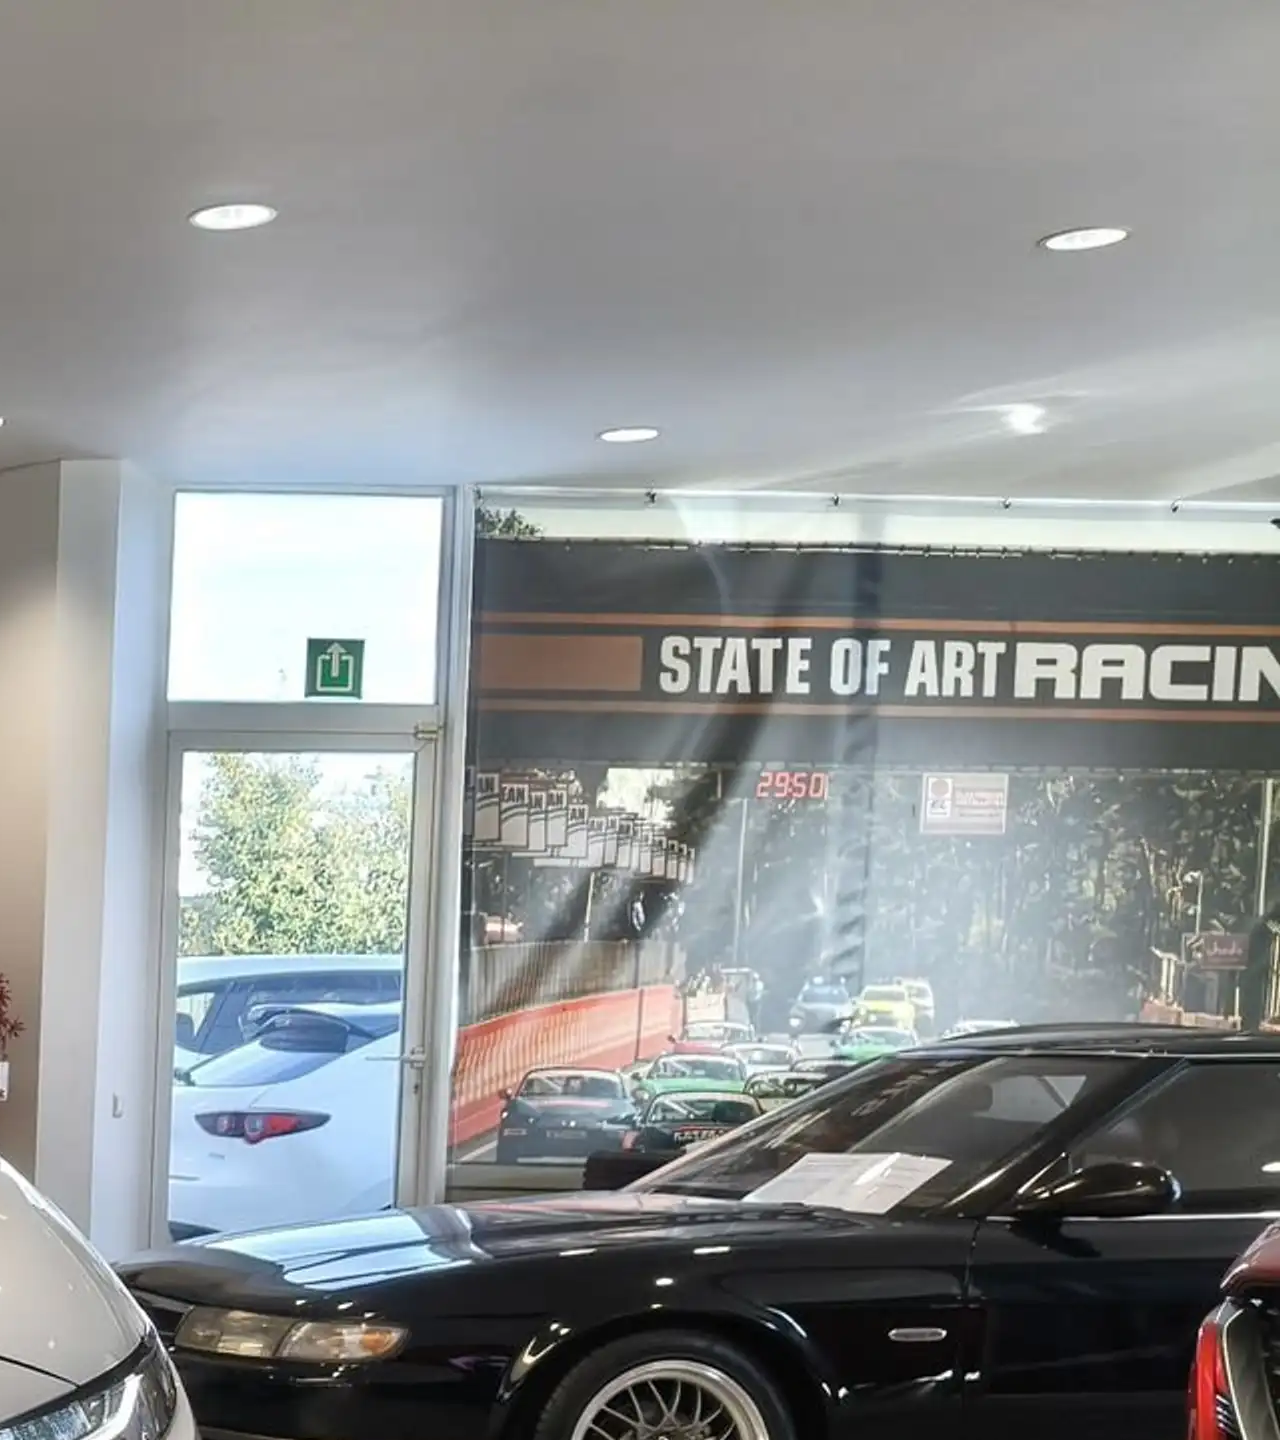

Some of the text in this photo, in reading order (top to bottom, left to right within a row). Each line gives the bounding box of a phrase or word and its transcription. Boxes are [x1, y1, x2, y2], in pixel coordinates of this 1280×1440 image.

[659, 636, 1280, 702] STATE OF ART RACIN
